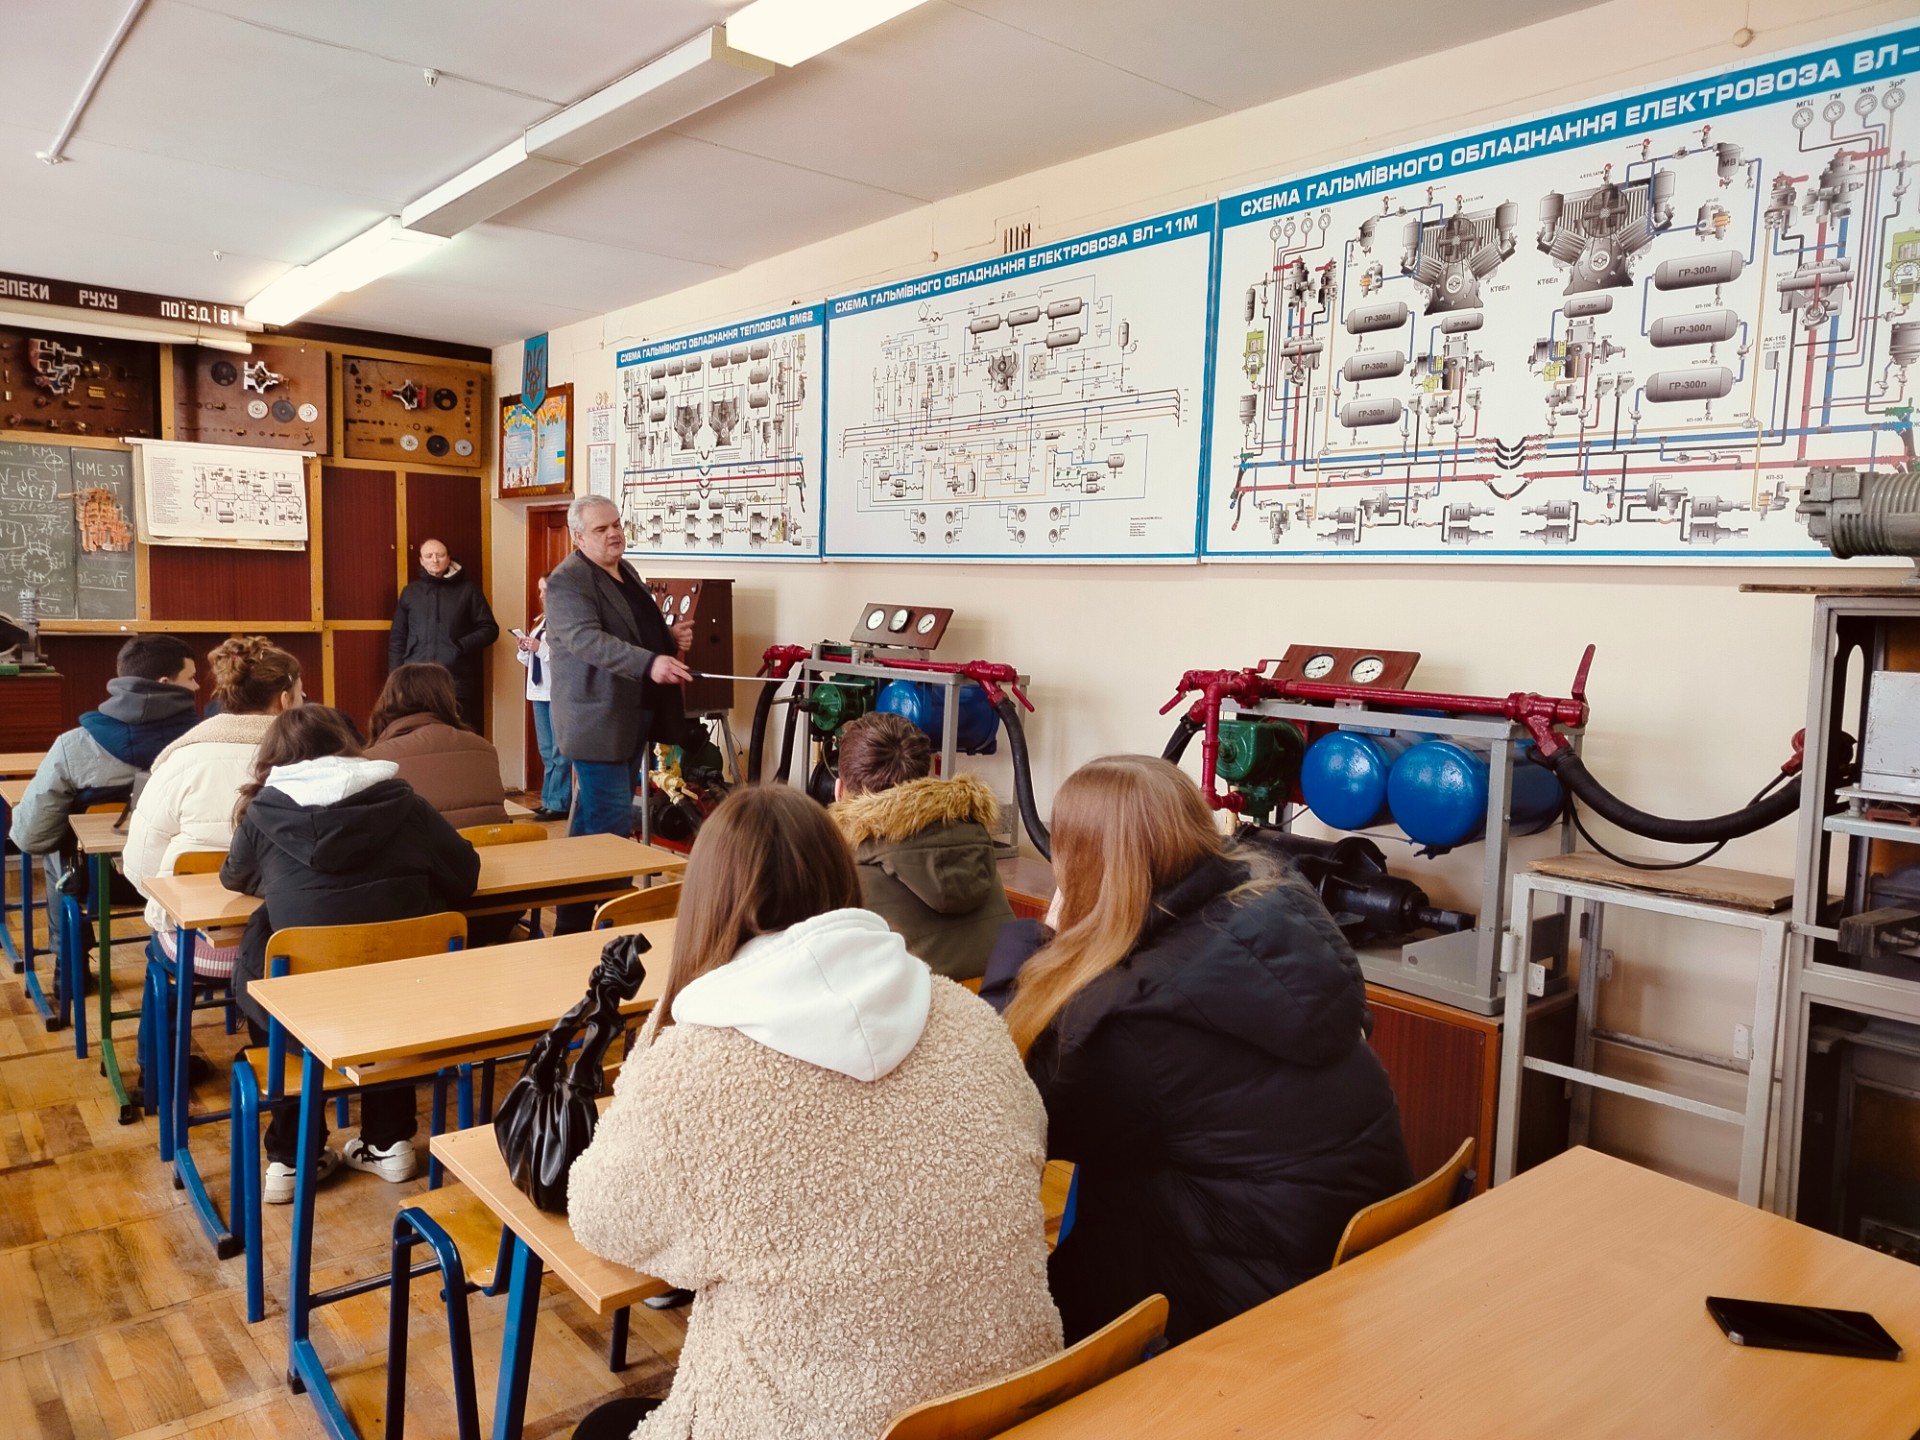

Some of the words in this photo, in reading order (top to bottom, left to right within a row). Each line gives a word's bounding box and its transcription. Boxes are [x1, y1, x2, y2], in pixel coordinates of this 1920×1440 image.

[1240, 187, 1300, 218] СХЕМА
[1450, 109, 1617, 167] ОБЛАДНАННЯ
[1625, 58, 1841, 128] ЕЛЕКТРОВОЗА
[835, 296, 869, 314] СХЕМА
[944, 256, 1026, 289] ОБЛАДНАННЯ
[1028, 233, 1129, 269] ЕЛЕКТРОВОЗА
[1132, 214, 1198, 244] ВЛ-11М
[1678, 264, 1717, 278] ГР-300л
[79, 289, 118, 310] РУХУ
[620, 349, 641, 363] СХЕМА
[688, 328, 738, 350] ОБЛАДНАННЯ
[740, 317, 787, 339] ТЕПЛОВОЗА
[789, 310, 814, 326] 2М62
[1673, 323, 1712, 336] ГР-300л
[1668, 378, 1707, 391] ГР-300л
